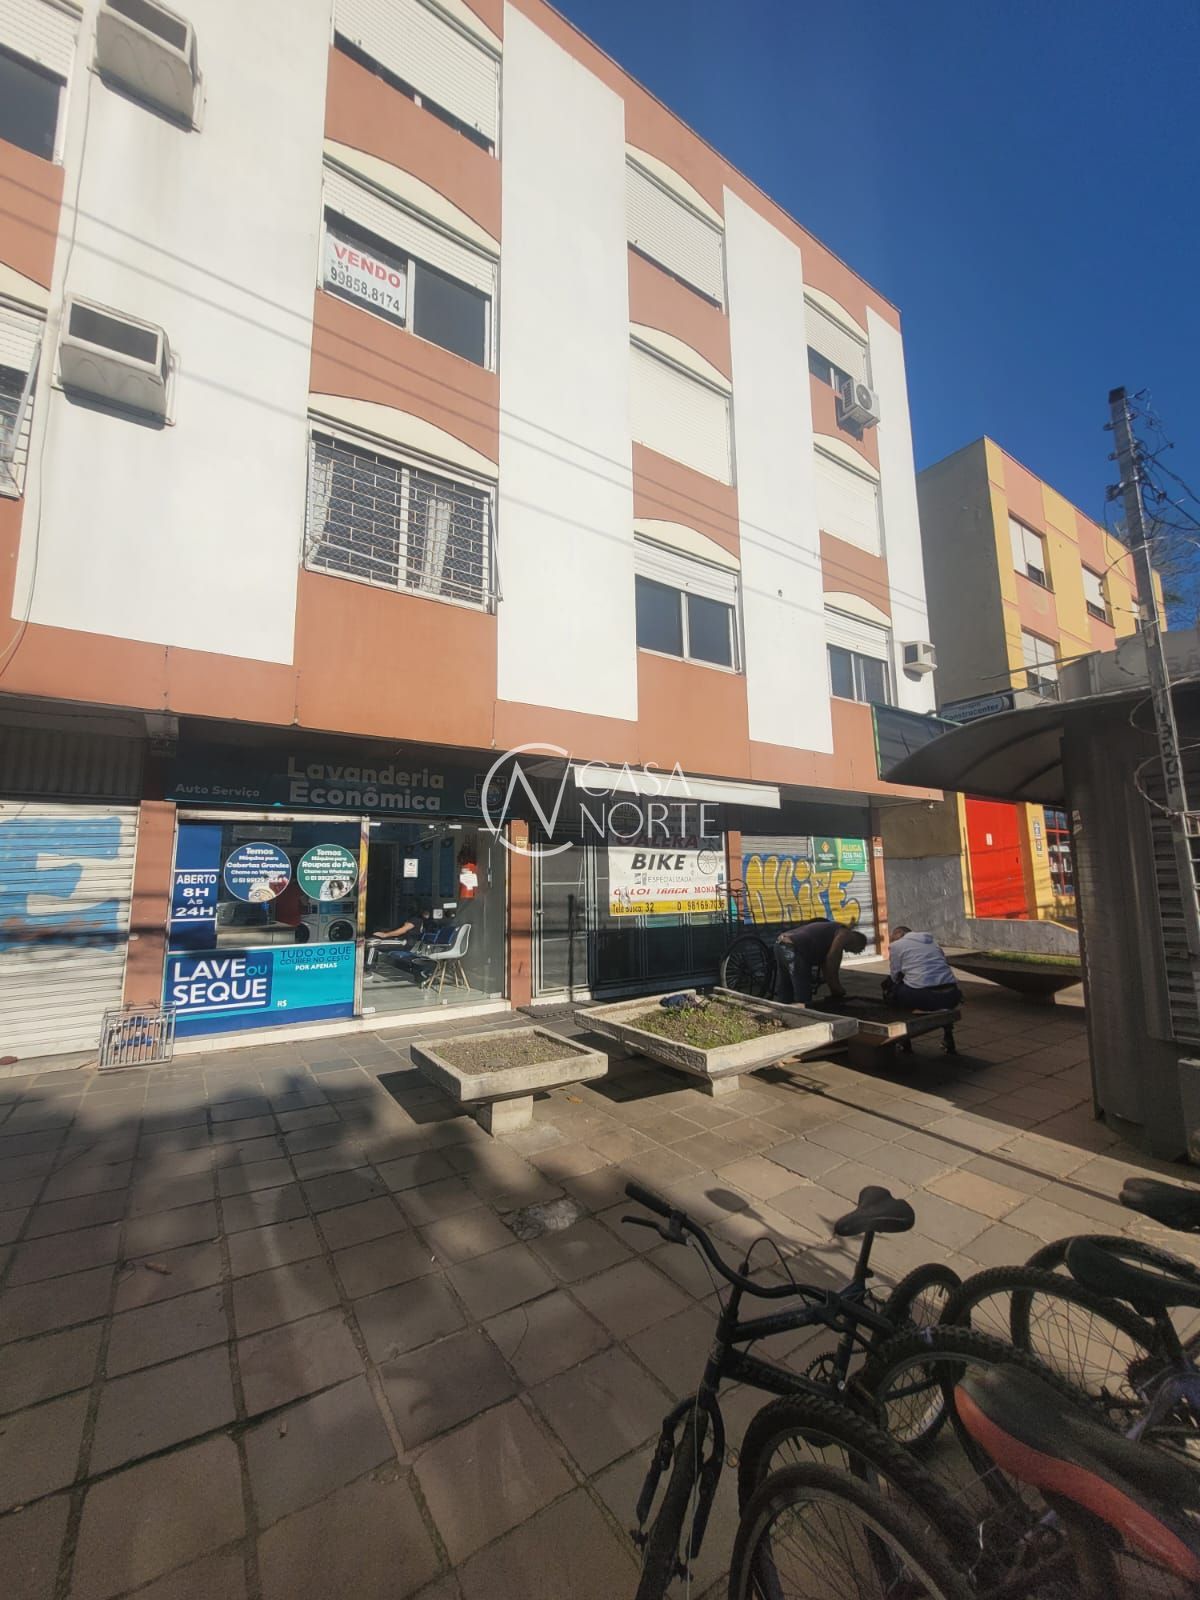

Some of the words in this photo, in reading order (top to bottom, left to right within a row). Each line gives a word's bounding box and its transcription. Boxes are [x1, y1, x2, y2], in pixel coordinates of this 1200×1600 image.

[334, 243, 401, 288] VENDO
[330, 266, 400, 312] 99858.8174
[288, 757, 445, 789] Lavanderia
[175, 783, 209, 795] Auto
[212, 785, 260, 798] Serviço
[289, 781, 441, 811] Econômica
[631, 853, 686, 871] BIKE
[176, 874, 217, 885] ABERTO
[182, 888, 209, 897] 8H
[613, 887, 651, 896] CLOI
[175, 906, 214, 917] 24H
[645, 902, 655, 913] 32
[280, 949, 312, 959] TUDO
[316, 947, 326, 957] O
[328, 946, 352, 956] QUE
[313, 955, 325, 963] NO
[326, 954, 350, 962] CESTO
[174, 958, 246, 983] LAVE
[246, 965, 268, 976] OU
[295, 963, 310, 971] POR
[310, 962, 338, 970] APENAS
[173, 978, 267, 1006] SEQUE
[277, 1000, 288, 1008] R$
